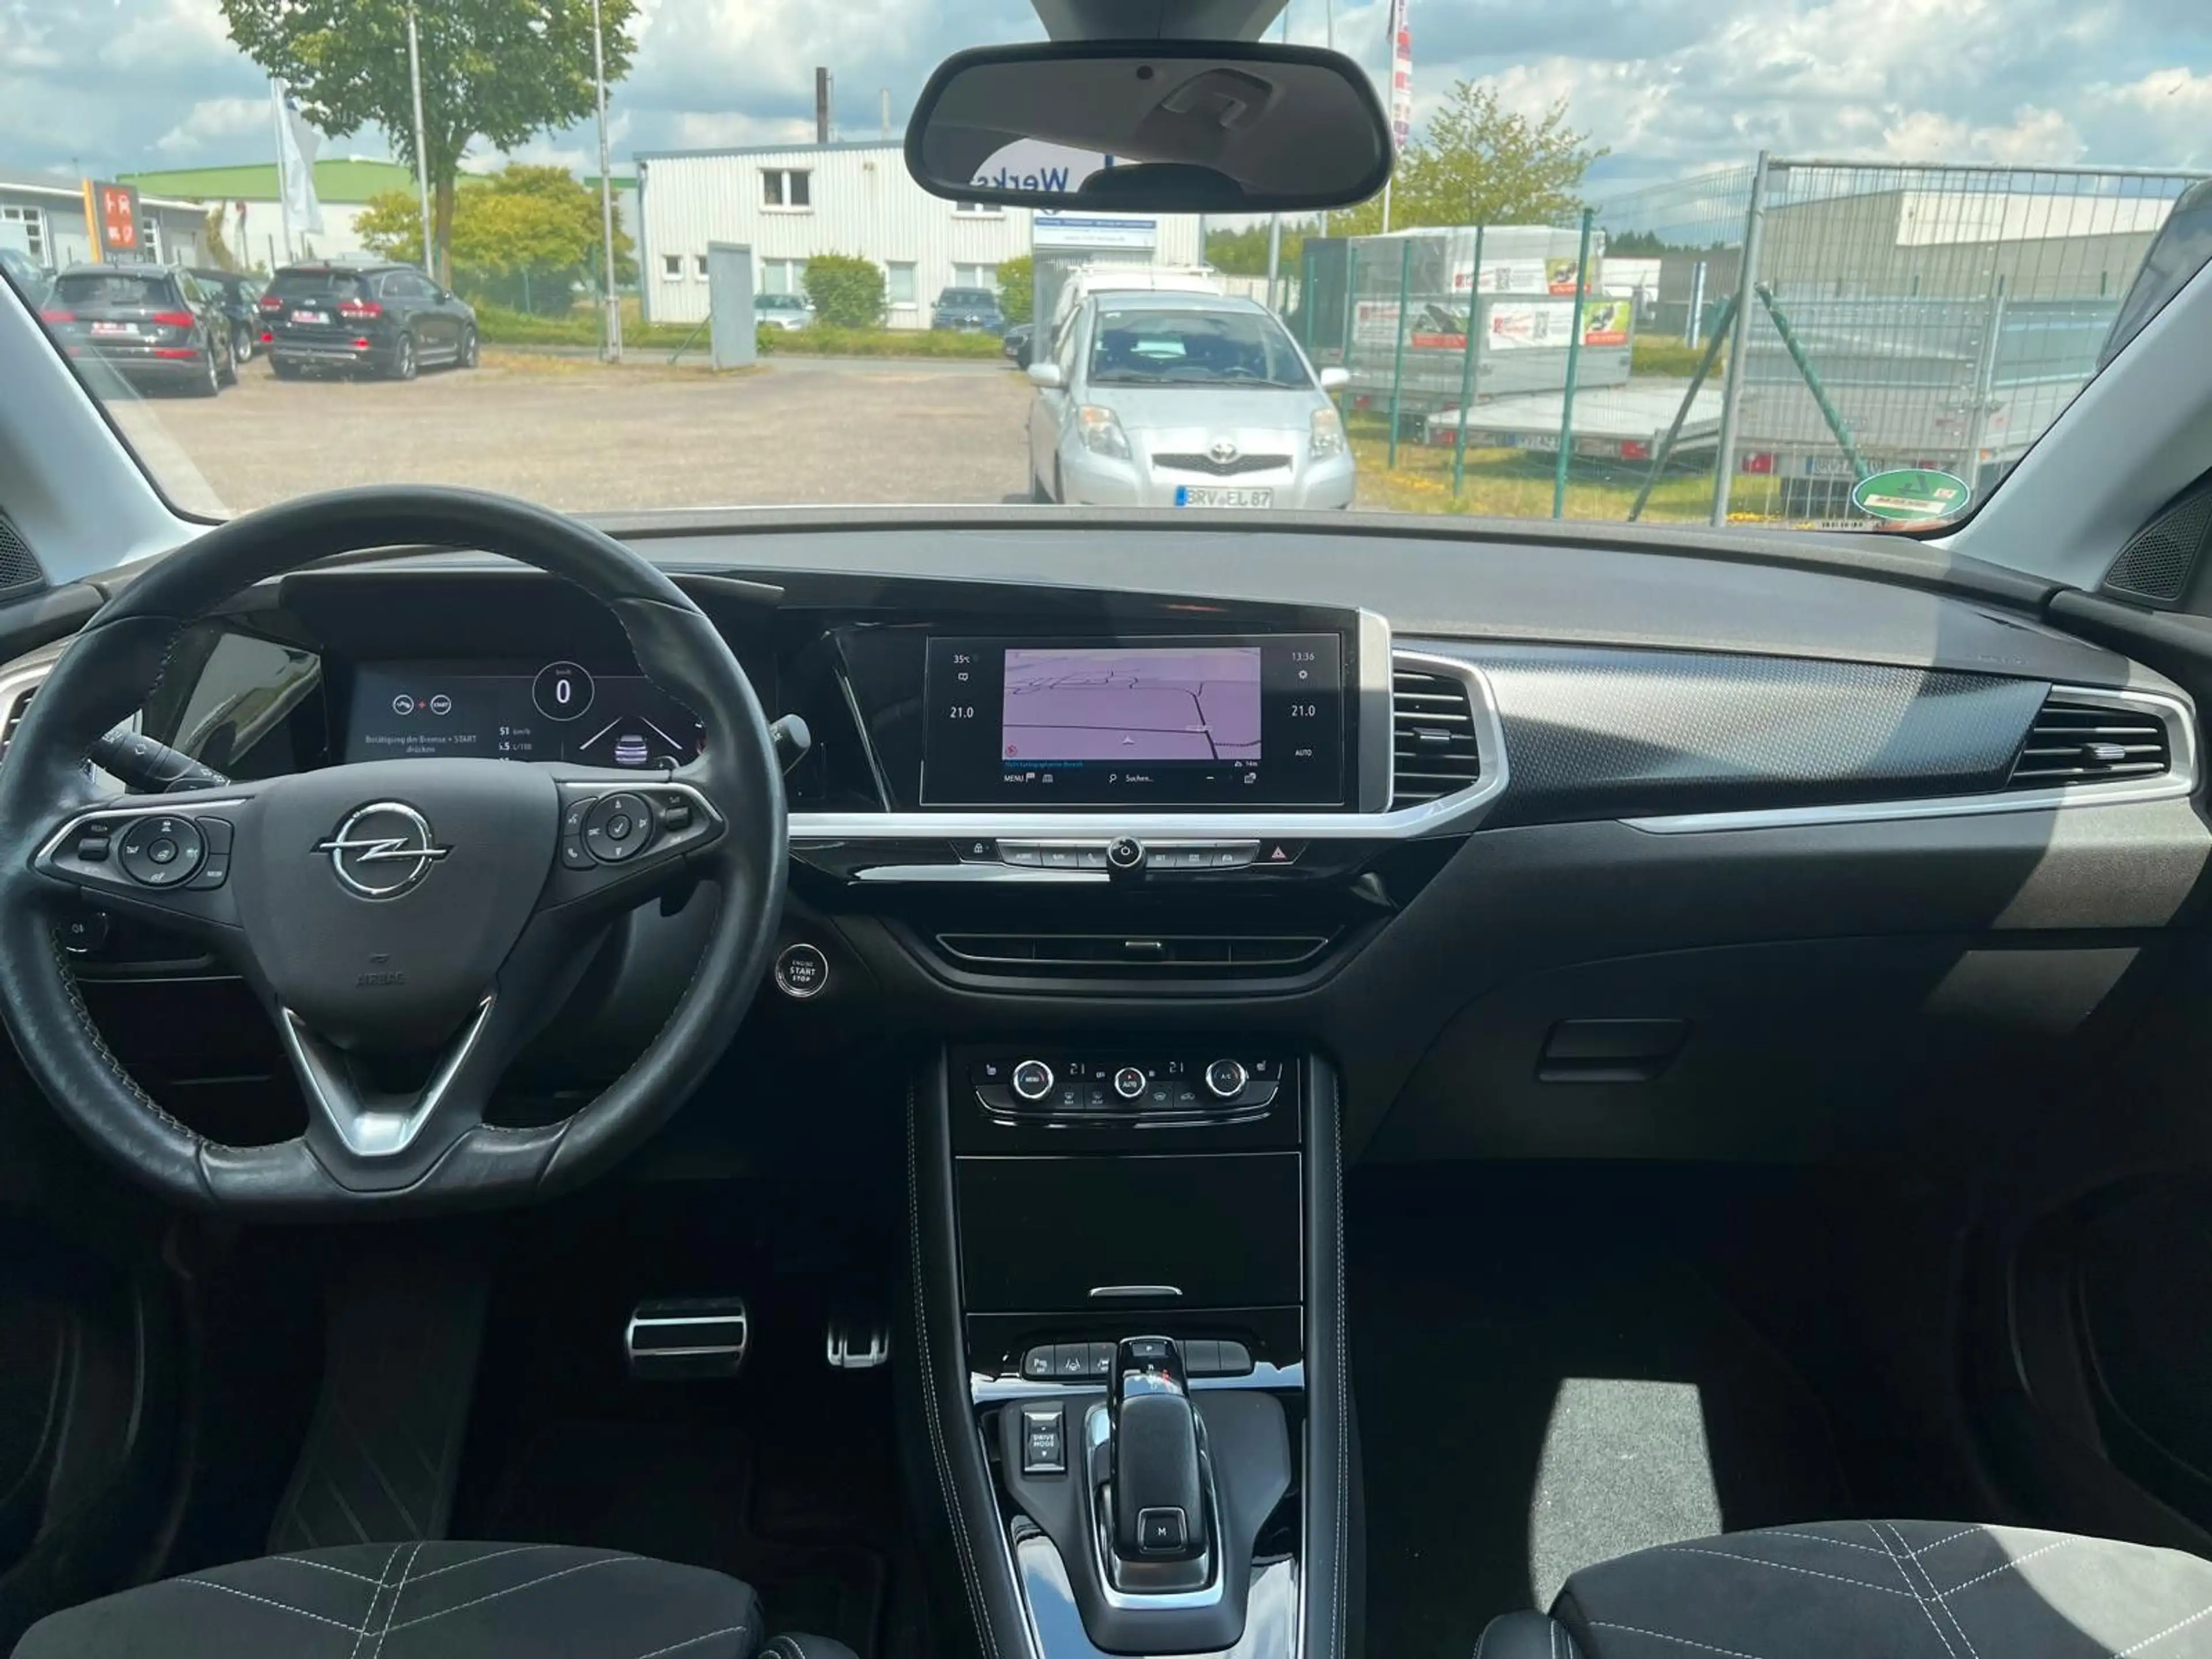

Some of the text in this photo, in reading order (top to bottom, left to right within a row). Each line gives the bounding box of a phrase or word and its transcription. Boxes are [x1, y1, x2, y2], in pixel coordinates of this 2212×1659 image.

[1228, 491, 1248, 506] EL
[1251, 491, 1270, 506] 87
[556, 679, 570, 703] 0
[950, 706, 974, 718] 21.0
[1291, 704, 1316, 717] 21.0
[1003, 774, 1024, 782] MENU
[790, 967, 816, 975] START
[1070, 1062, 1085, 1075] 21
[1169, 1061, 1184, 1074] 21
[1158, 1527, 1166, 1536] M
